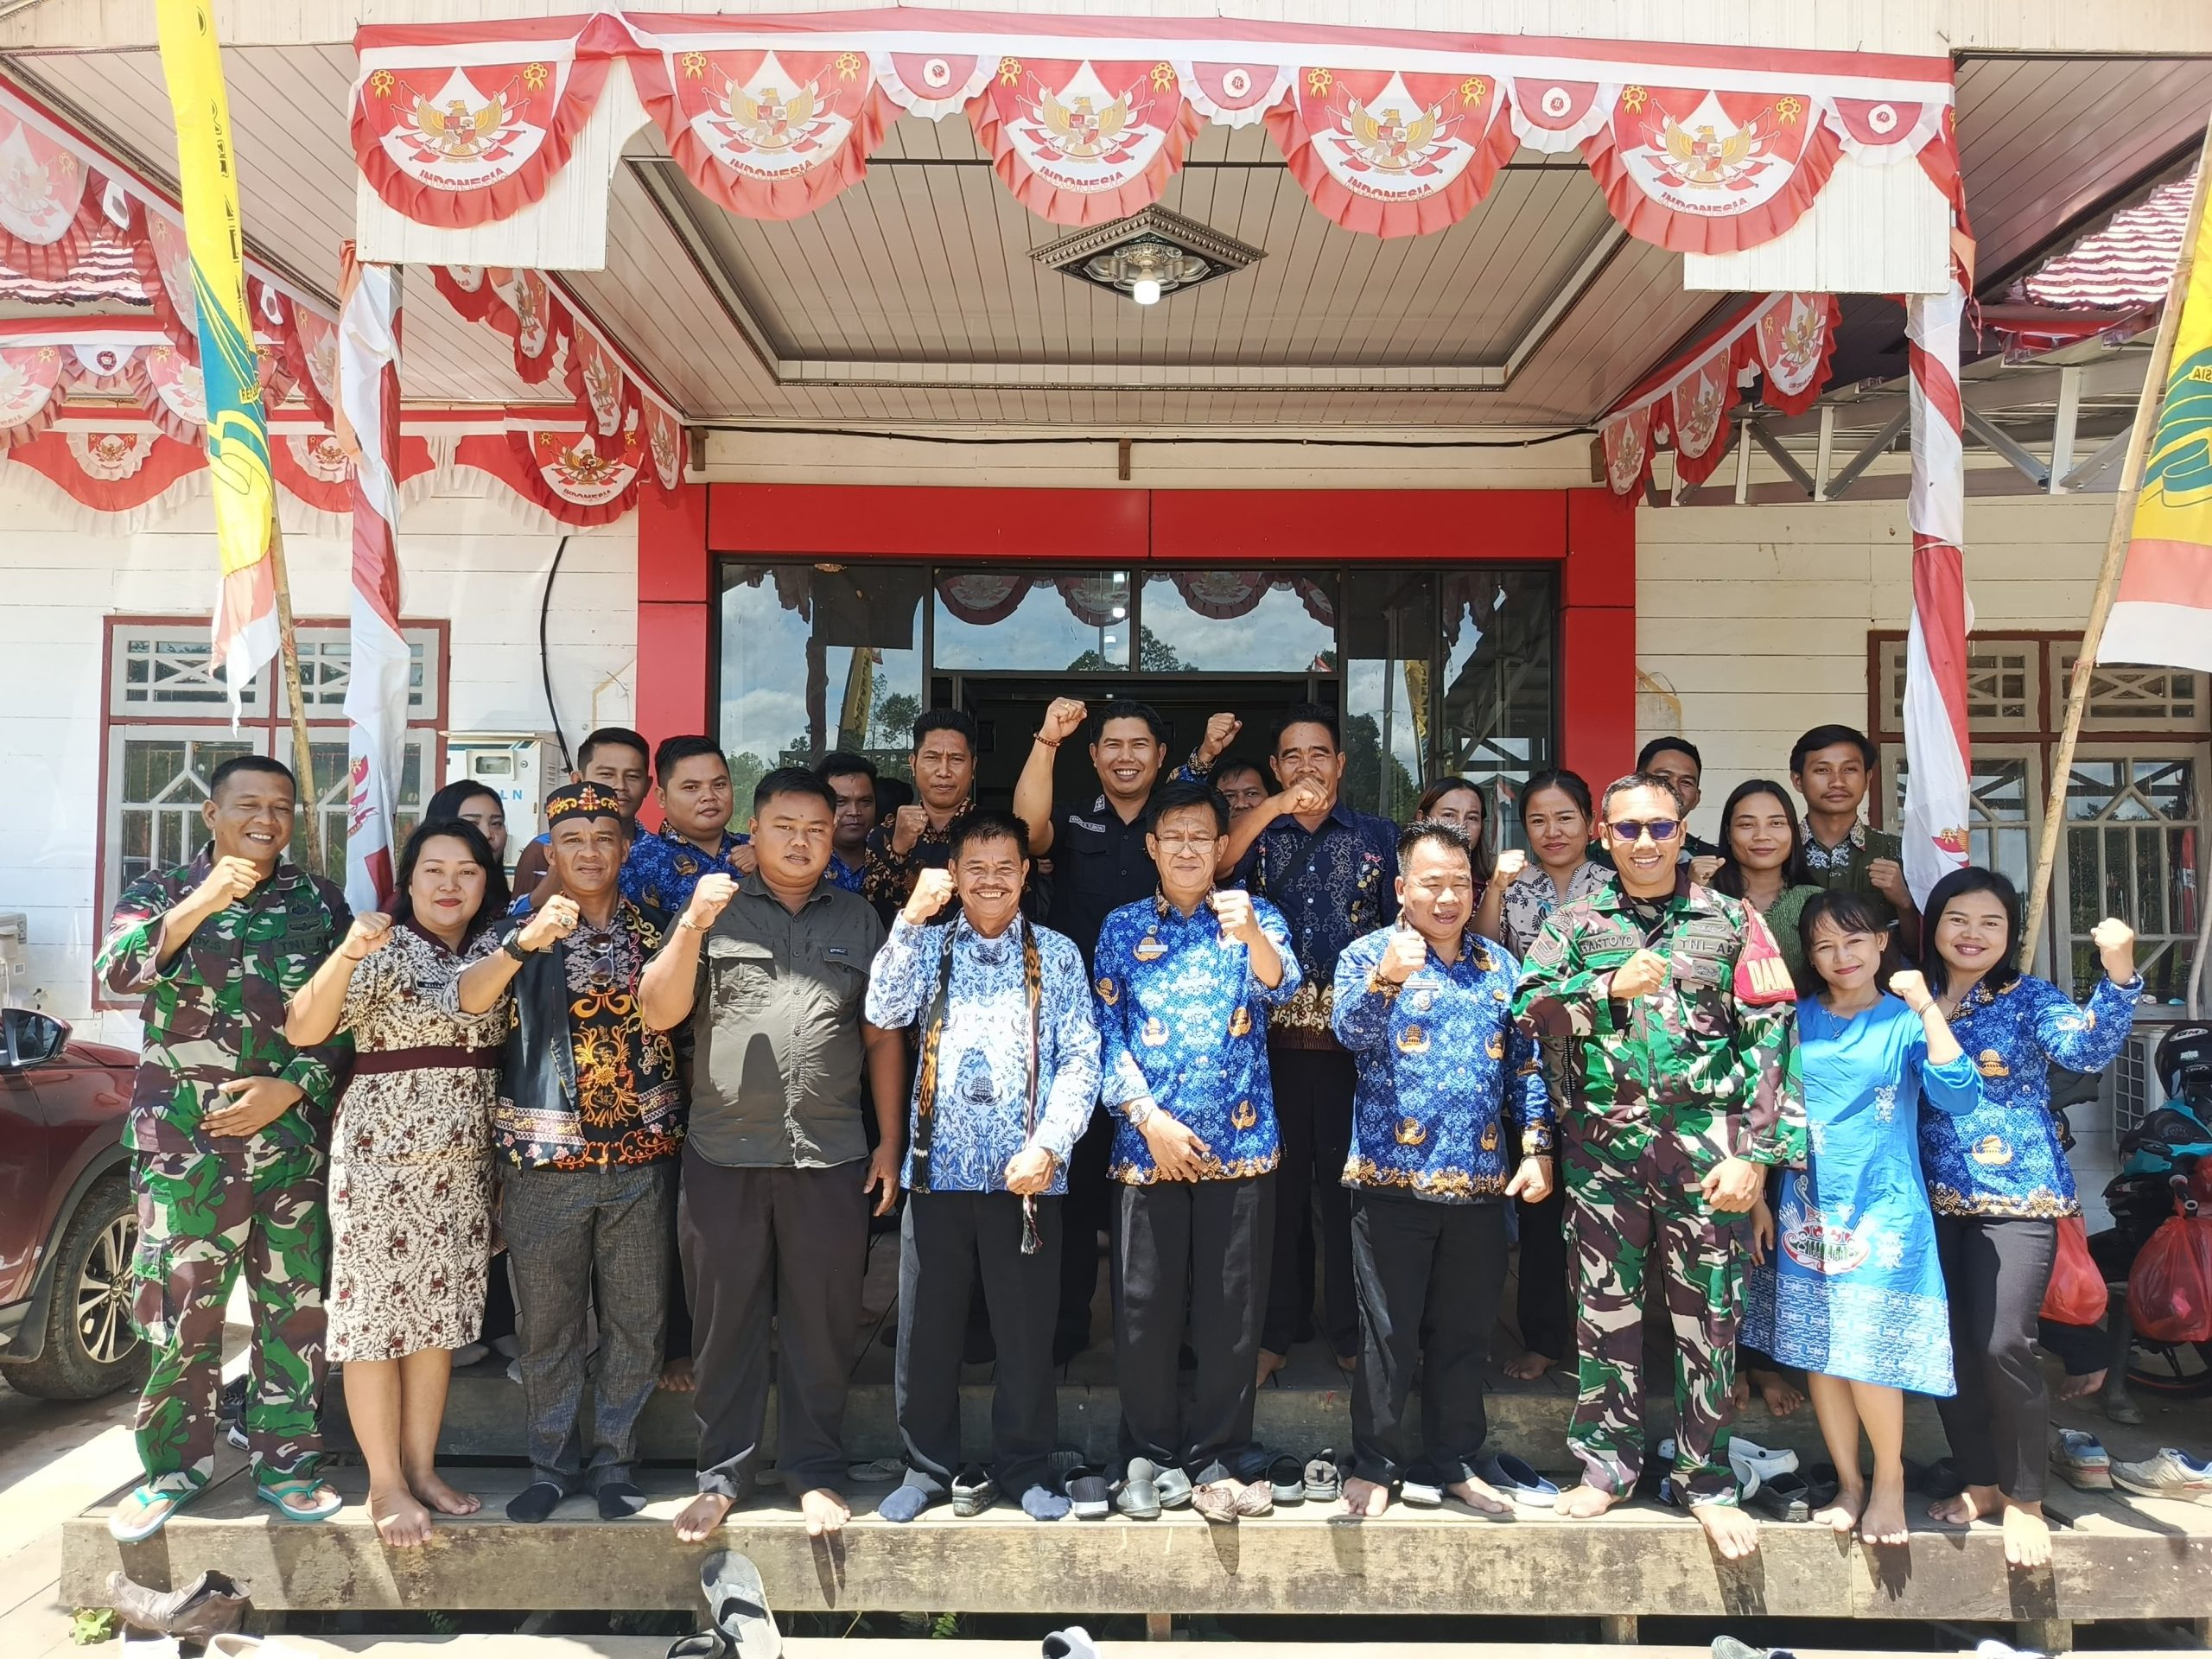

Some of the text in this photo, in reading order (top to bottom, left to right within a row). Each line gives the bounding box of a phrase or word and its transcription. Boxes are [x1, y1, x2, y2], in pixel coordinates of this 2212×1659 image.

[418, 168, 508, 191] INDONESIA
[728, 159, 817, 181] INDONESIA
[1038, 166, 1127, 192] INDONESIA
[1344, 176, 1433, 201] INDONESIA
[1659, 192, 1751, 216] INDONESIA
